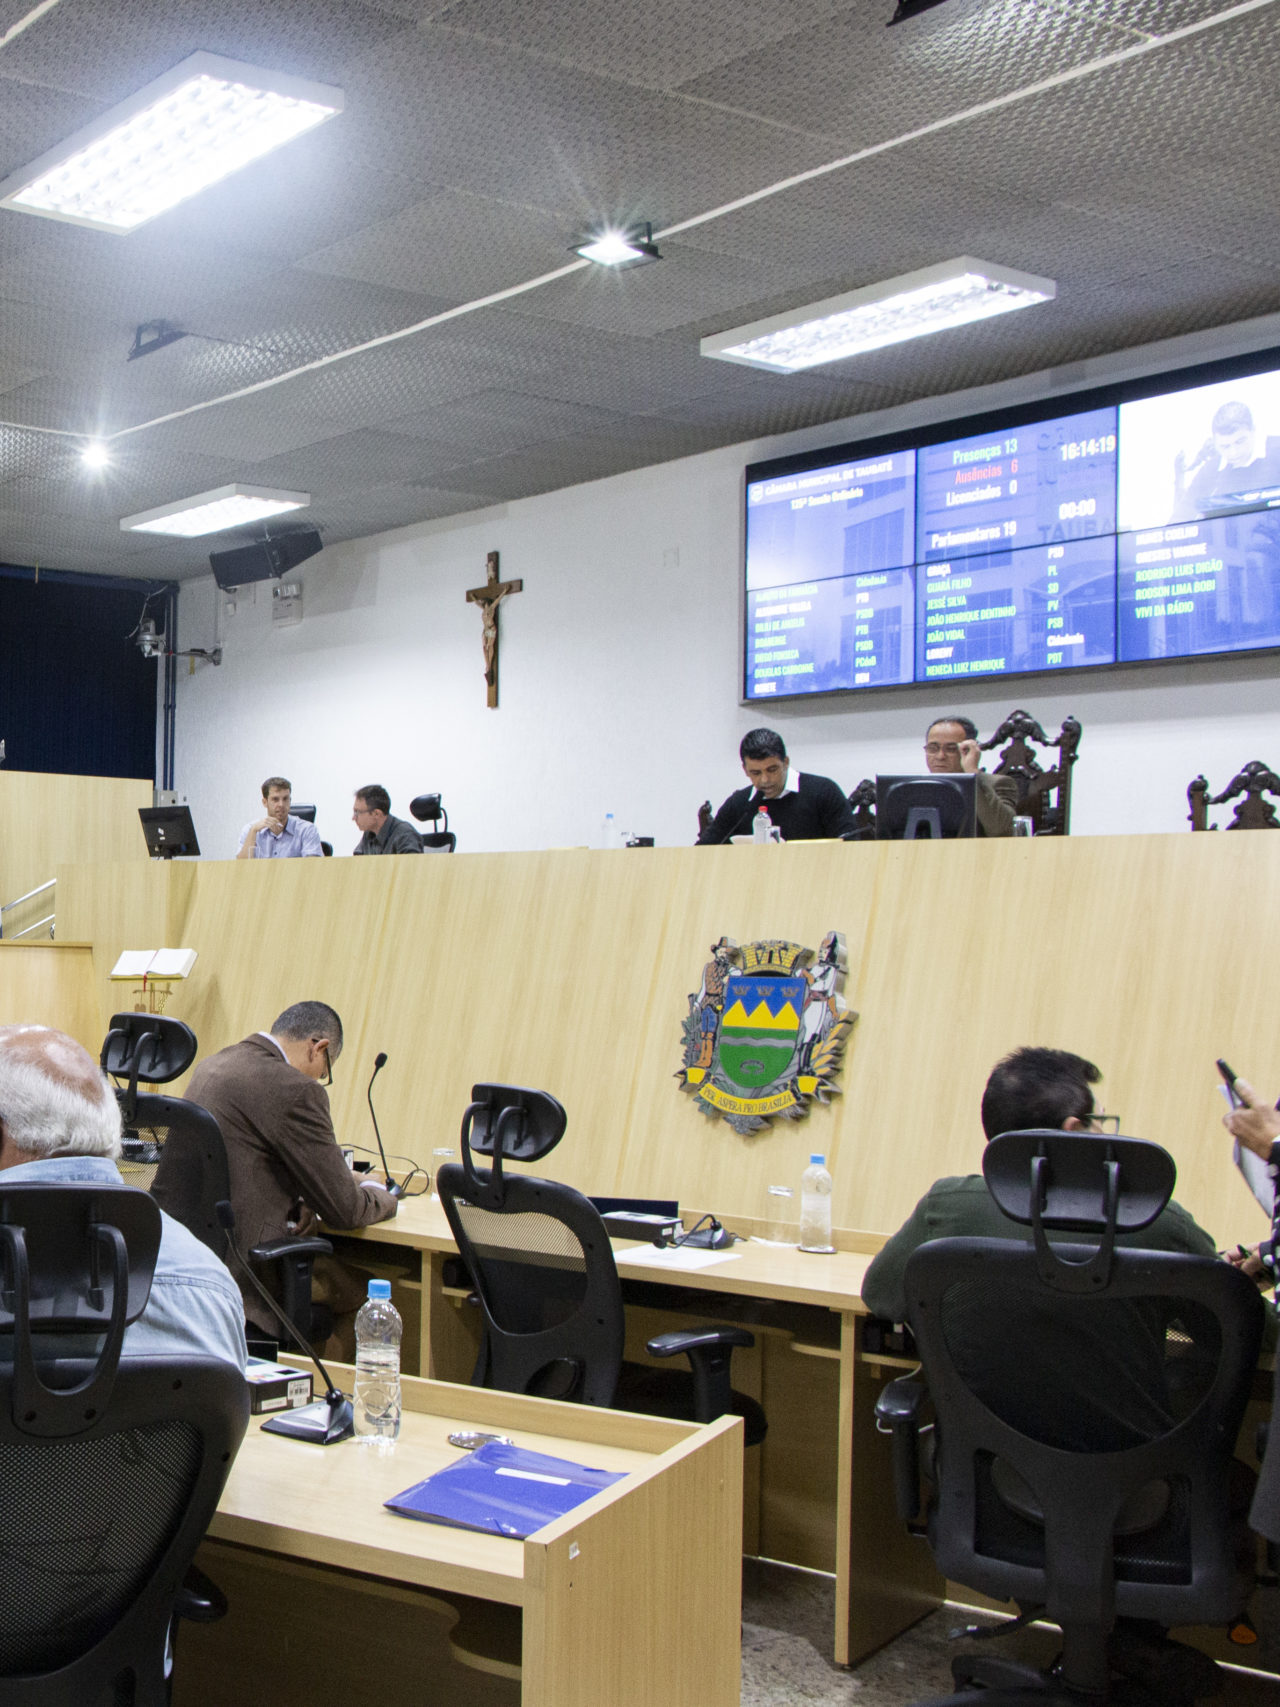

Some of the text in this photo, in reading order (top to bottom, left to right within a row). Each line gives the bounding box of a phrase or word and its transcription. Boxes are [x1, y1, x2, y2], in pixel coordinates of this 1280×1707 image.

[953, 445, 1001, 466] Presenças
[1004, 438, 1018, 454] 13
[1060, 434, 1116, 461] 16:14:19
[955, 458, 1018, 485] Ausências 6
[946, 479, 1017, 506] Licenciados 0
[1058, 498, 1096, 520] 00:00
[931, 520, 1017, 549] Parlamentares 19
[1049, 564, 1058, 576] PL
[1136, 559, 1223, 583] RODRIGO LUIS DIGÃO
[927, 577, 972, 593] GUARÁ FILHO
[1136, 580, 1216, 601] RODSON LIMA BOBI
[927, 594, 967, 610] JESSÉ SILVA
[1048, 599, 1059, 612] PV
[1136, 600, 1194, 619] VIVI DA RÁDIO
[927, 605, 1016, 627] JOÃO HENRIQUE DENTINHO
[1048, 617, 1063, 629] PSB
[927, 628, 965, 643] JOÃO VIDAL
[953, 661, 969, 674] LUIZ
[969, 657, 1005, 672] HENRIQUE
[1048, 652, 1063, 664] PDT
[703, 1086, 717, 1100] PER
[718, 1096, 742, 1113] ASPERA
[743, 1103, 758, 1113] PRO
